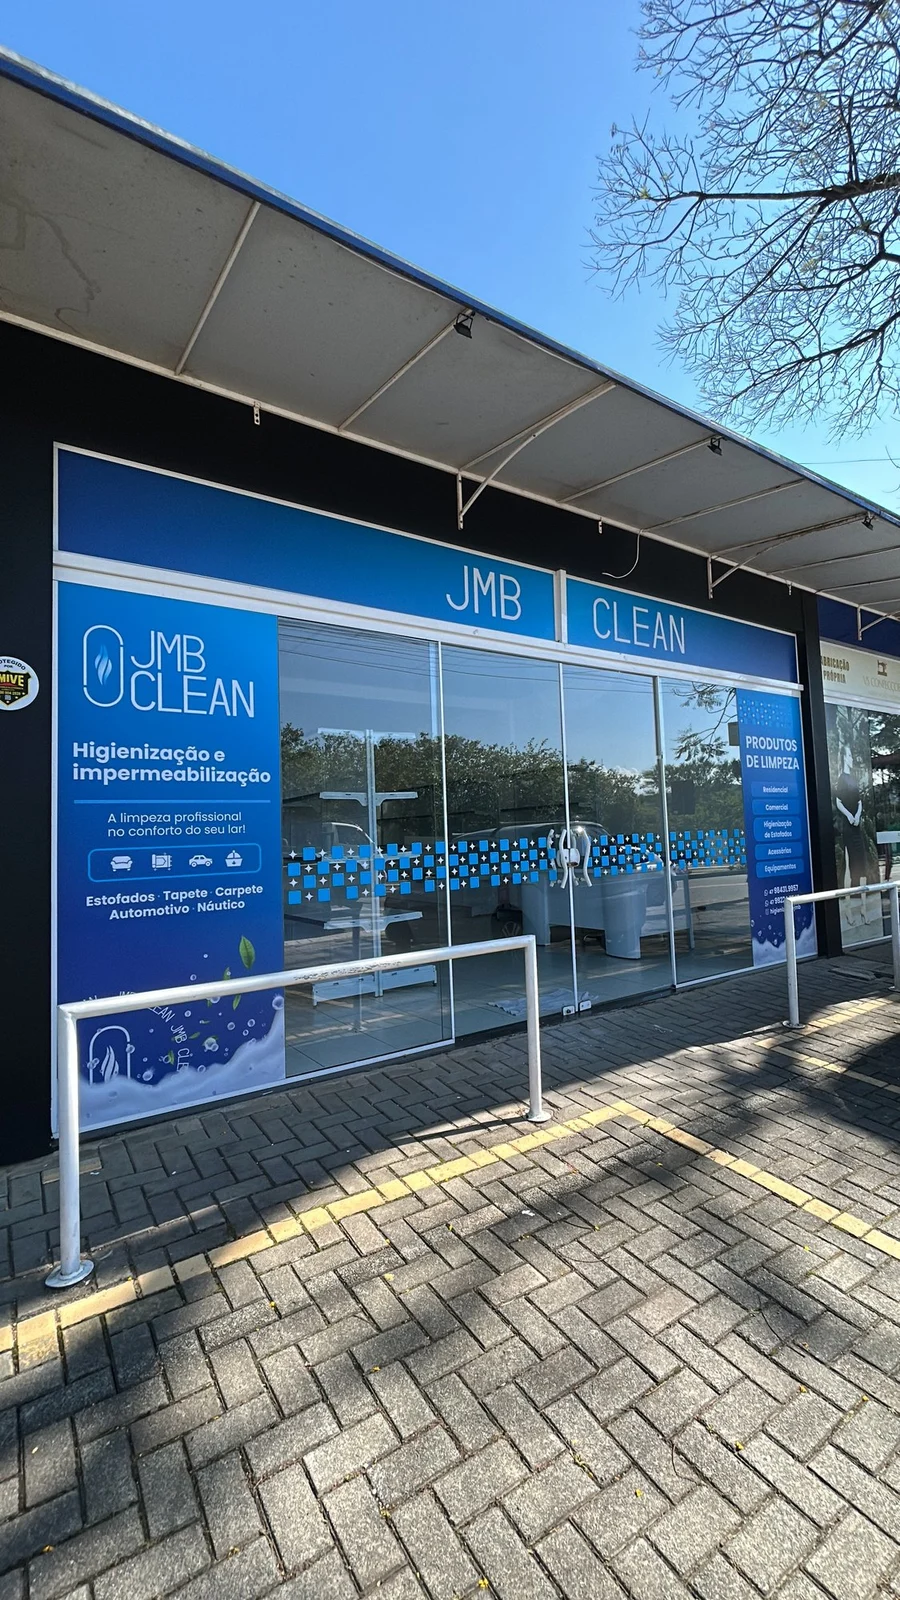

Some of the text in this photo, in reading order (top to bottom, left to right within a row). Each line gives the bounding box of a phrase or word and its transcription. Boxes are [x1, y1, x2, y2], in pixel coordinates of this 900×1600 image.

[445, 565, 686, 654] JMB CLEAN
[130, 630, 206, 673] JMB
[130, 670, 255, 718] CLEAN
[745, 735, 798, 752] PRODUTOS
[72, 741, 226, 766] Higienização e
[746, 755, 800, 770] DE LIMPEZA
[72, 763, 271, 787] impermeabilização
[762, 785, 789, 793] Residencial
[765, 803, 789, 811] Comercial
[107, 811, 242, 825] A limpeza profissional
[763, 819, 793, 829] Higienização
[107, 824, 246, 837] no conforto do seu lar!
[764, 830, 793, 839] de Estofados
[767, 847, 792, 855] Acessórios
[764, 863, 797, 873] Equipamentos
[86, 884, 264, 907] Estofados Tapete Carpete
[109, 899, 245, 920] Automotivo Náutico
[148, 1005, 175, 1023] EAN
[170, 1024, 188, 1044] JMB
